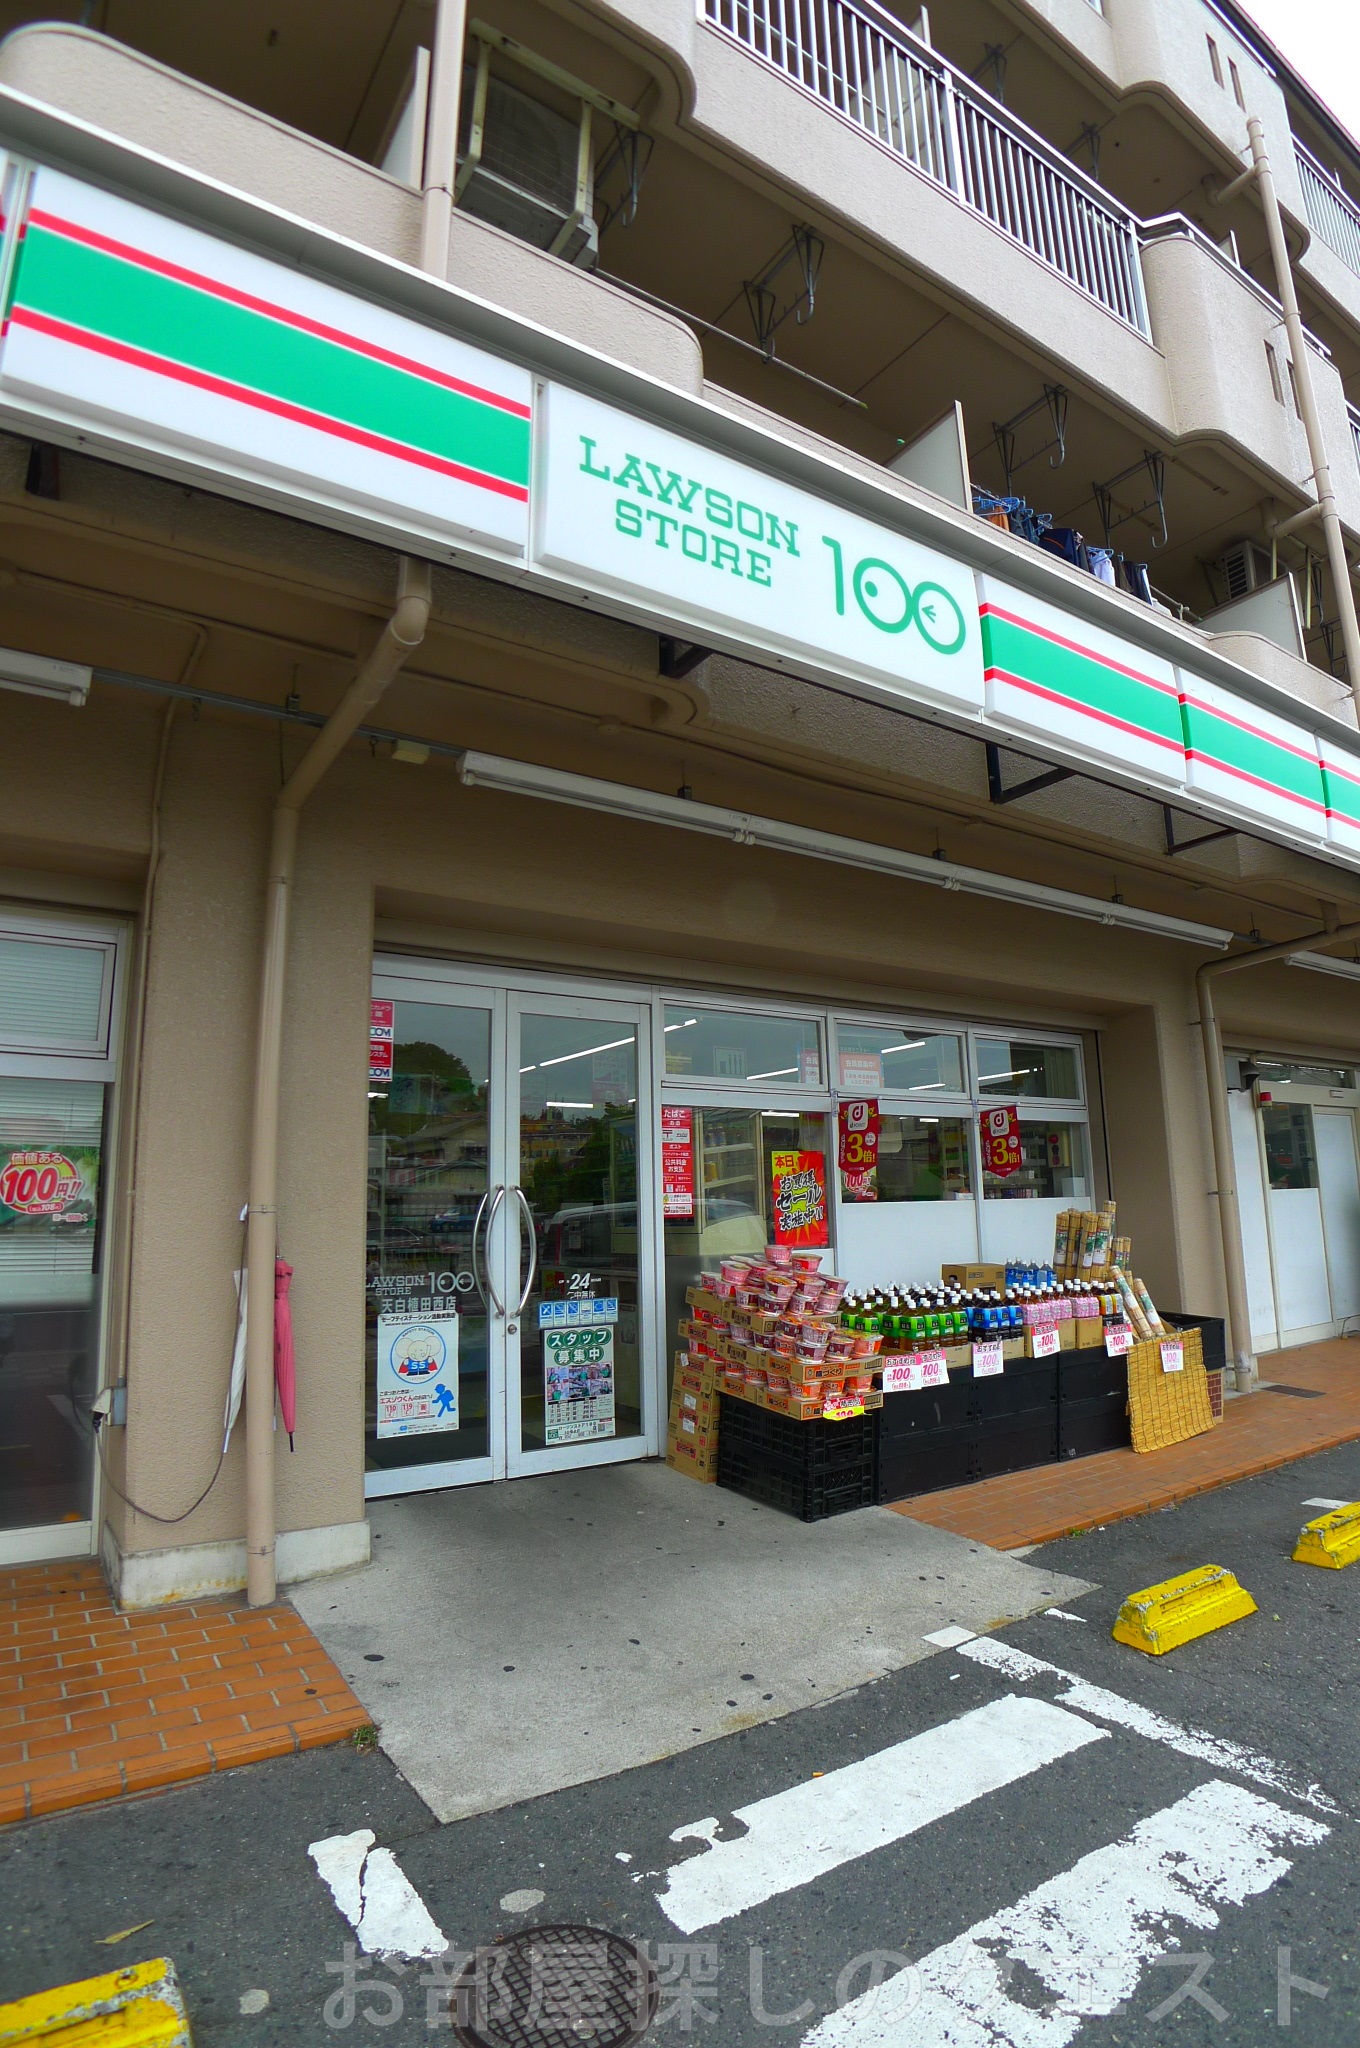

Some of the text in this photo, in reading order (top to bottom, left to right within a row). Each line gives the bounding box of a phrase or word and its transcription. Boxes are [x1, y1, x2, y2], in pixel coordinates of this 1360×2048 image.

[579, 435, 800, 557] LAWSON
[615, 498, 771, 587] STORE
[822, 535, 966, 655] 100
[664, 1109, 686, 1118] たばこ
[12, 1152, 63, 1165] 価値ある
[775, 1155, 794, 1168] 本日
[776, 1183, 823, 1211] セール
[428, 1271, 475, 1293] 100
[569, 1273, 591, 1290] 24
[375, 1287, 412, 1296] STORE
[382, 1295, 457, 1313] 天白植田西店
[551, 1331, 607, 1346] スタッフ
[558, 1348, 600, 1364] 募集中
